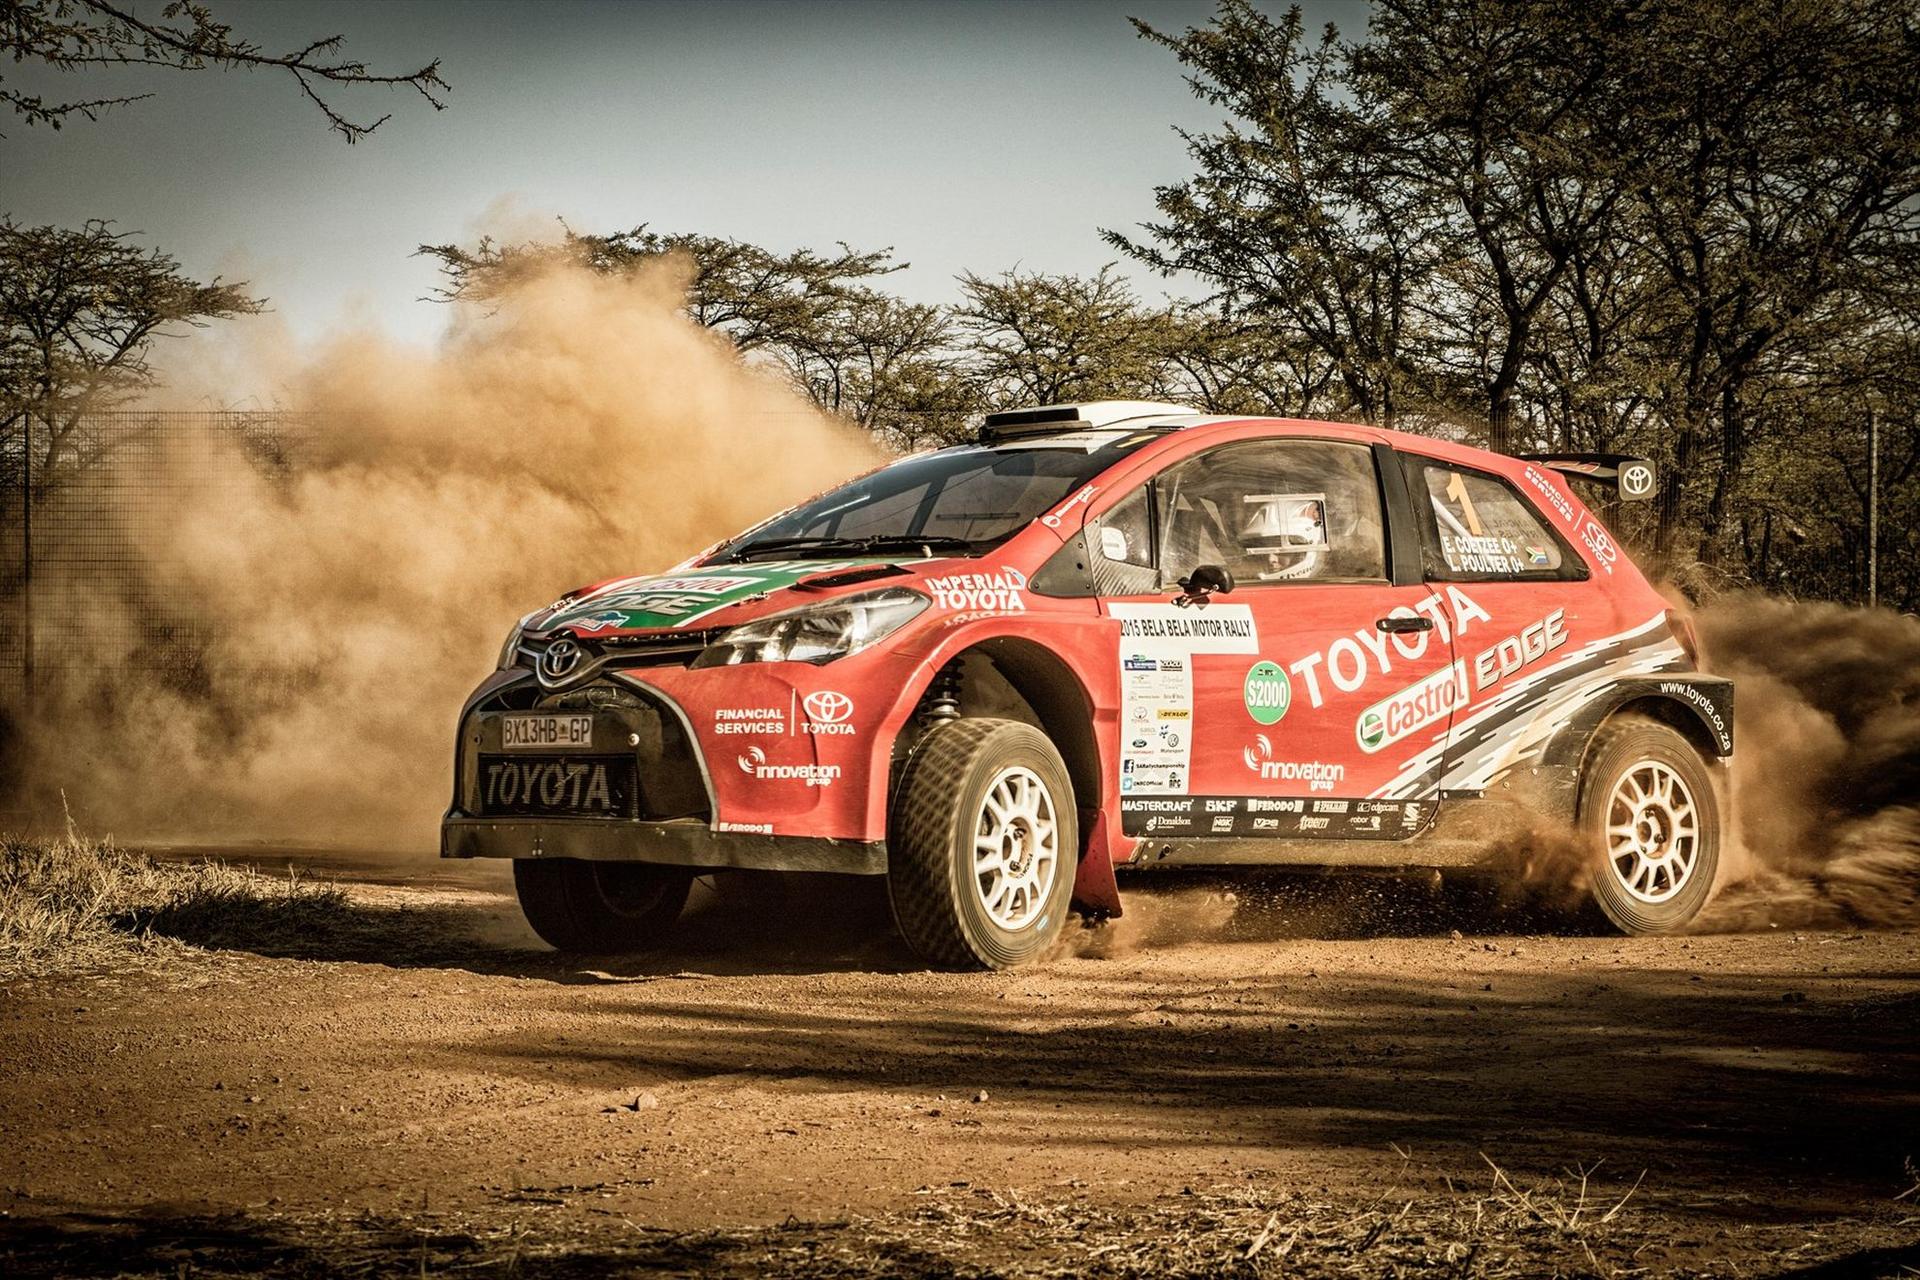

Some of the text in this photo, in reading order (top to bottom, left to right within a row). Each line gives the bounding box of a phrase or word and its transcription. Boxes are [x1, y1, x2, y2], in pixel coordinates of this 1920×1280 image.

[1446, 472, 1483, 536] 1
[1441, 536, 1455, 553] E.
[1455, 536, 1502, 554] COETZEE
[1581, 530, 1613, 576] TOYOTA
[1447, 554, 1461, 572] L.
[1460, 554, 1511, 573] POULTER
[925, 573, 1024, 591] IMPERIAL
[933, 589, 1026, 610] TOYOTA
[1142, 619, 1165, 637] BELA
[1166, 619, 1190, 637] BELA
[1191, 619, 1224, 637] MOTOR
[1225, 619, 1251, 638] RALLY
[1290, 585, 1492, 709] TOYOTA
[1475, 607, 1570, 693] EDGE
[1247, 680, 1287, 708] S2000
[1386, 662, 1467, 738] Castrol
[715, 708, 784, 720] FINANCIAL
[1660, 682, 1732, 750] www.toyota.co.za
[504, 717, 591, 745] BX13HB GP
[715, 722, 784, 735] SERVICES
[801, 723, 856, 735] TOYOTA
[756, 763, 841, 779] innovation
[1261, 760, 1343, 781] innovation
[487, 762, 612, 809] TOYOTA
[806, 777, 831, 787] group
[1310, 778, 1334, 792] group
[1121, 800, 1192, 812] MASTERCRAFT
[1205, 800, 1237, 812] SKF
[1256, 800, 1295, 812] FERODO
[1371, 802, 1400, 814] edgecam
[1157, 816, 1192, 826] Donaldson
